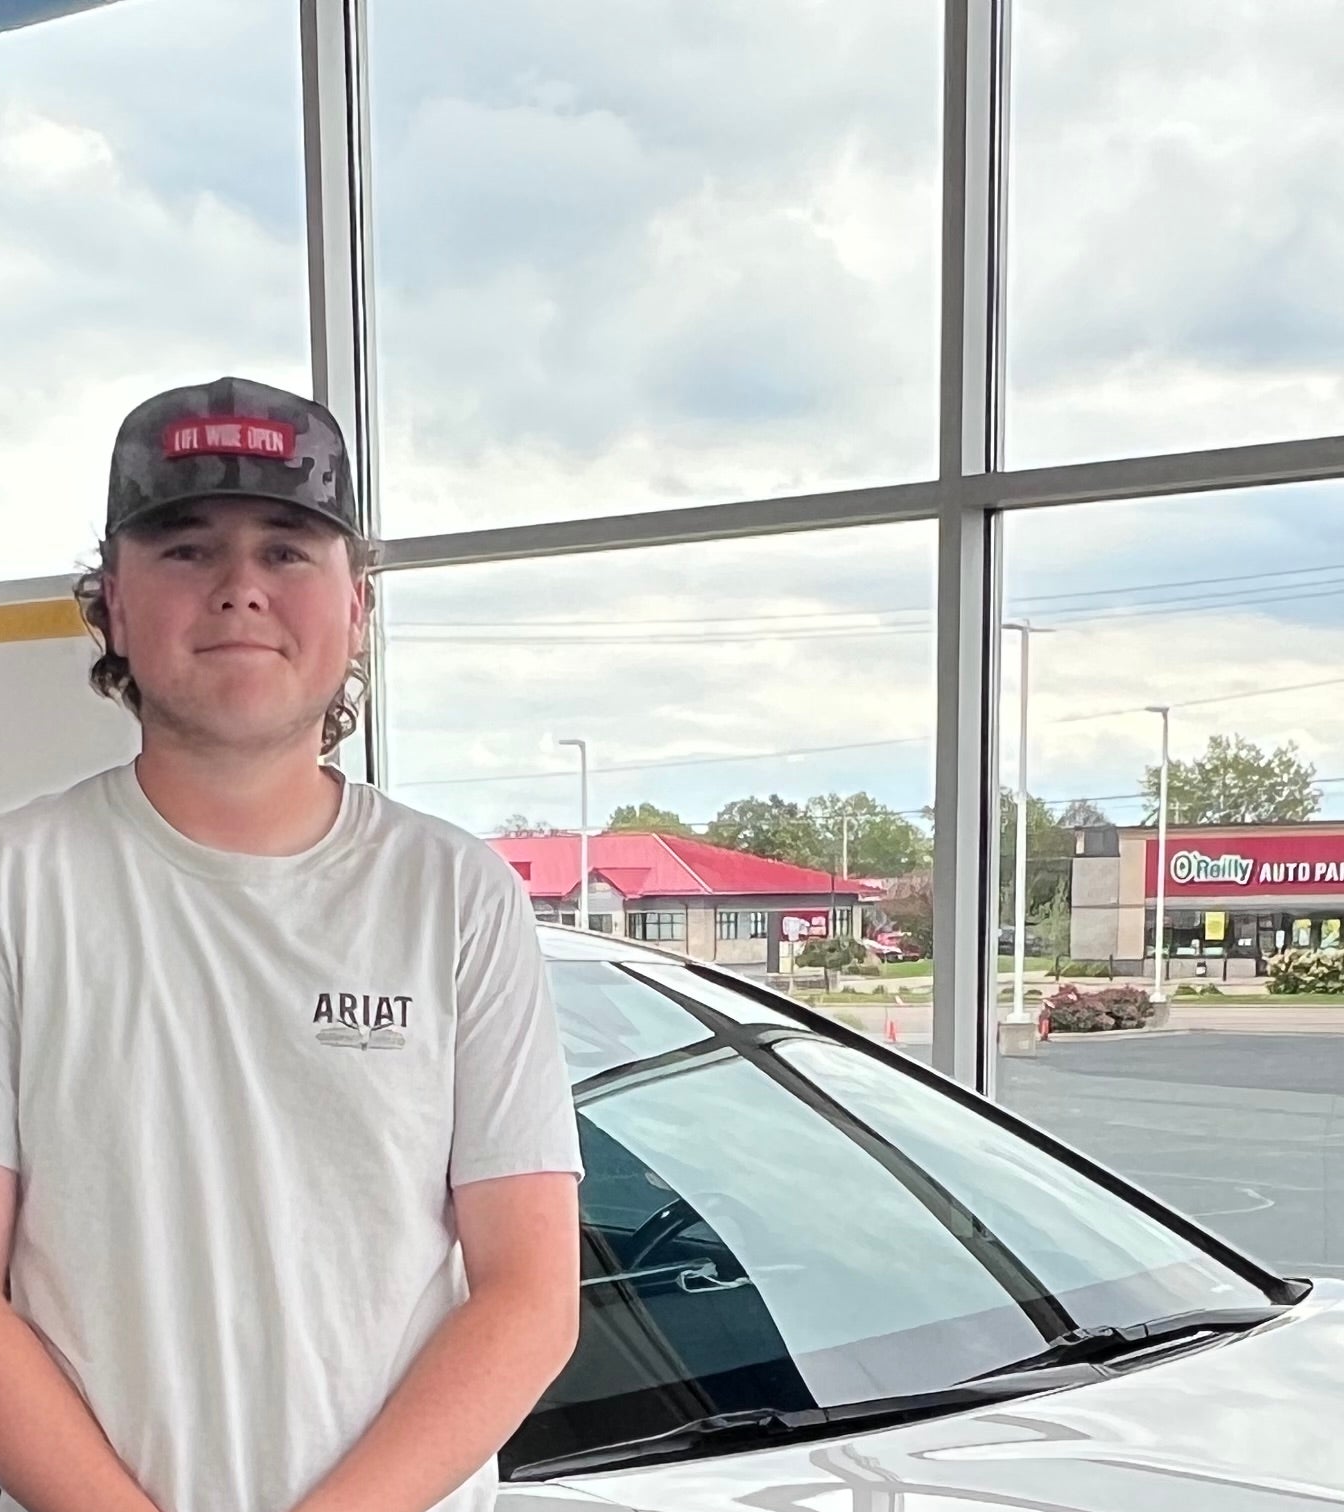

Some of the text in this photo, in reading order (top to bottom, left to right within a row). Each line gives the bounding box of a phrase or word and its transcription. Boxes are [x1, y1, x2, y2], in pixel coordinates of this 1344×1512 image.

[248, 426, 284, 454] OPEN
[1171, 851, 1253, 884] O'Reilly
[1259, 862, 1309, 883] AUTO
[313, 993, 413, 1028] ARIAT
